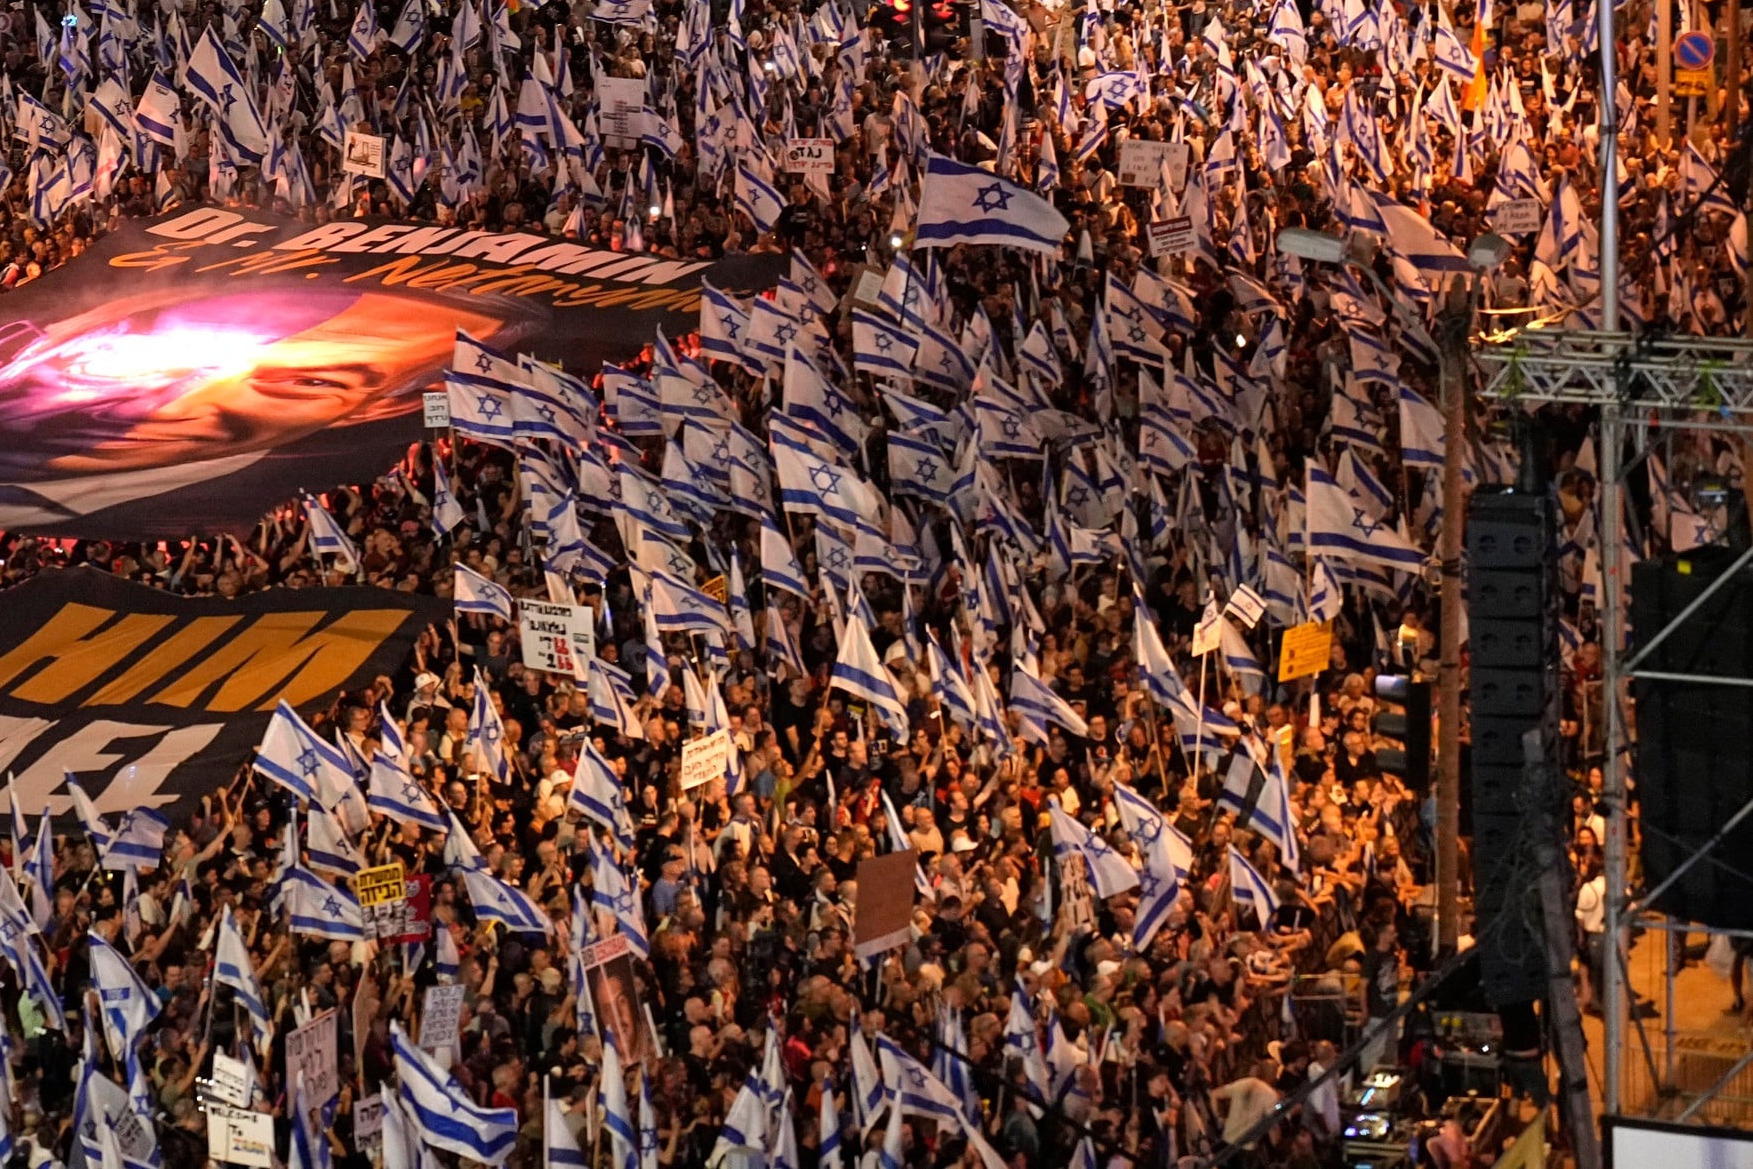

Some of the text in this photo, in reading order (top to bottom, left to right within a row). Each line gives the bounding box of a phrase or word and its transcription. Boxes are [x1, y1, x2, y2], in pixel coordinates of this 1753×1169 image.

[796, 146, 822, 159] נגד
[145, 207, 715, 285] Dr. BENJAMIN
[361, 881, 402, 905] הביזה
